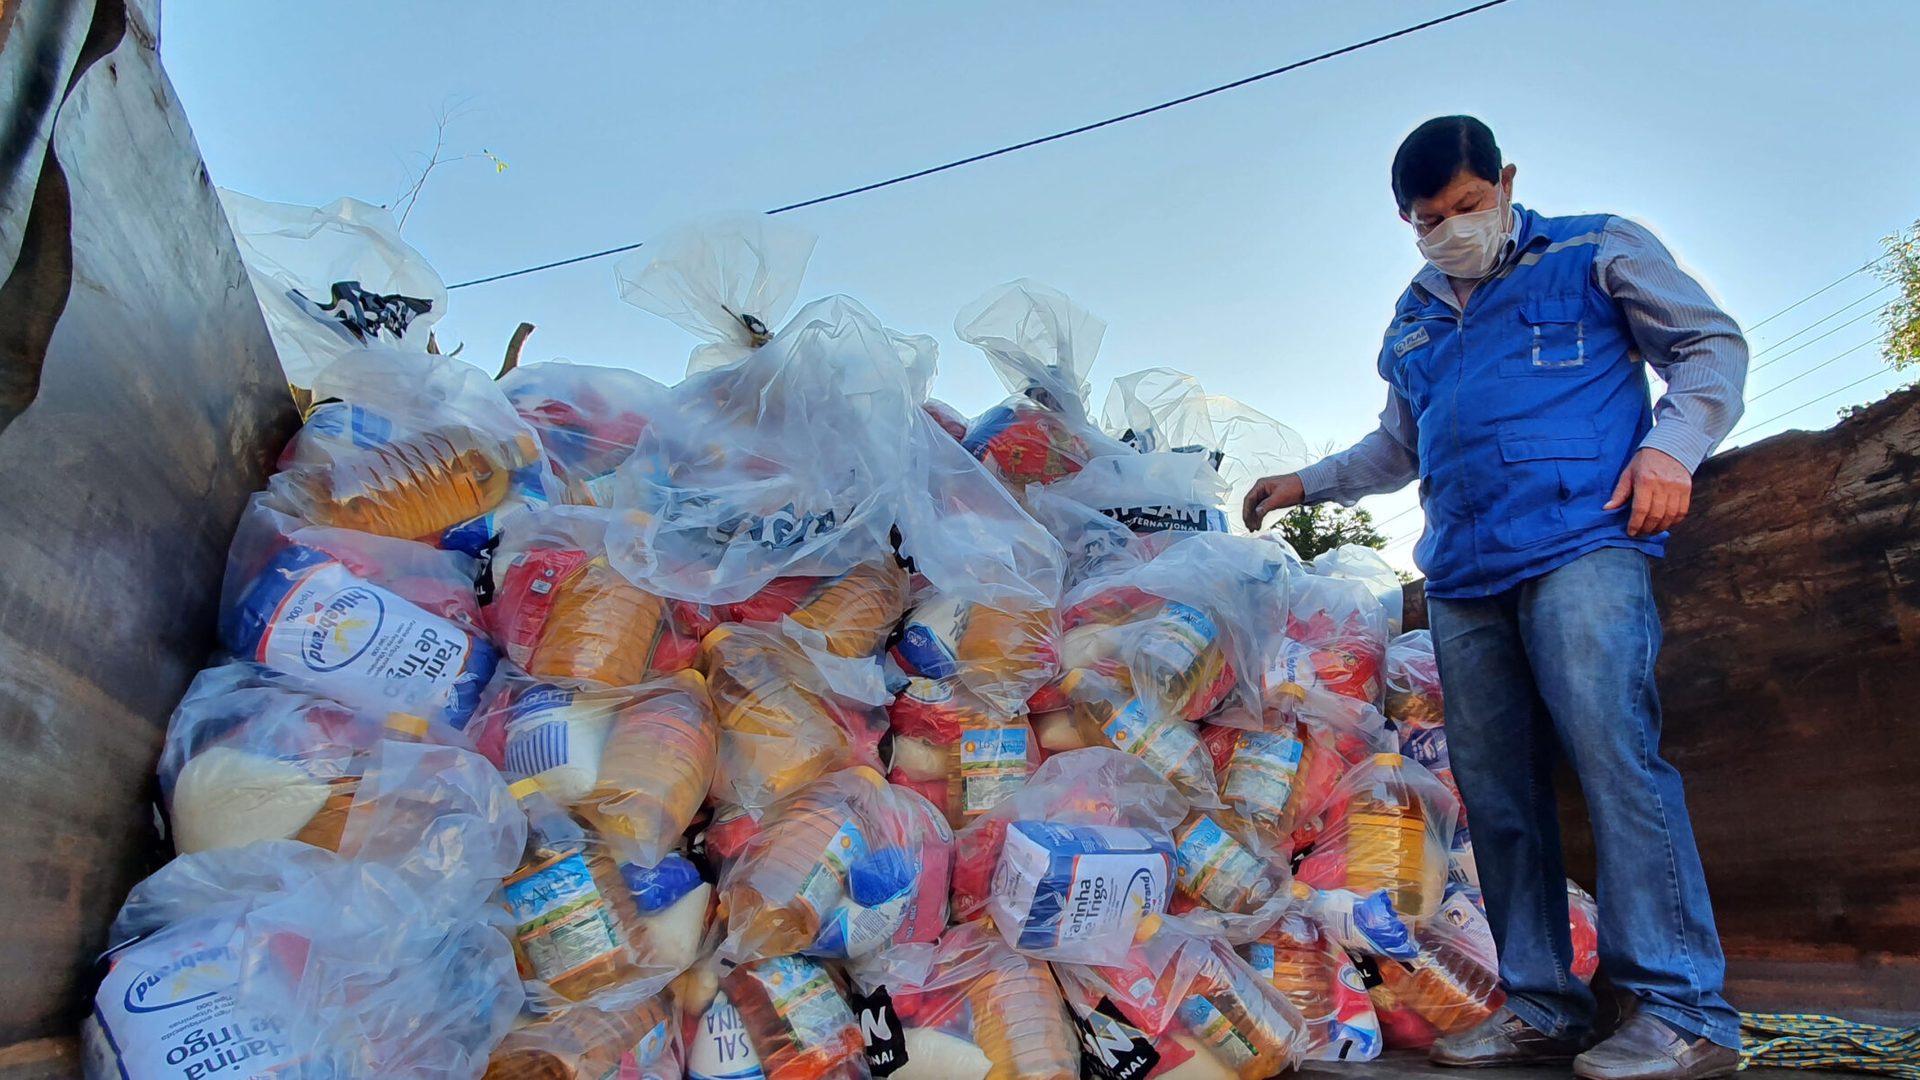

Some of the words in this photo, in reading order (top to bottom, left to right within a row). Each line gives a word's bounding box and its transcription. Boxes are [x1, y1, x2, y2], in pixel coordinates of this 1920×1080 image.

[297, 590, 315, 605] Tipo
[414, 628, 439, 655] de
[1085, 876, 1108, 921] Trigo
[1142, 876, 1152, 918] ebrand
[166, 1024, 253, 1065] Trigo
[714, 1031, 750, 1063] SAL
